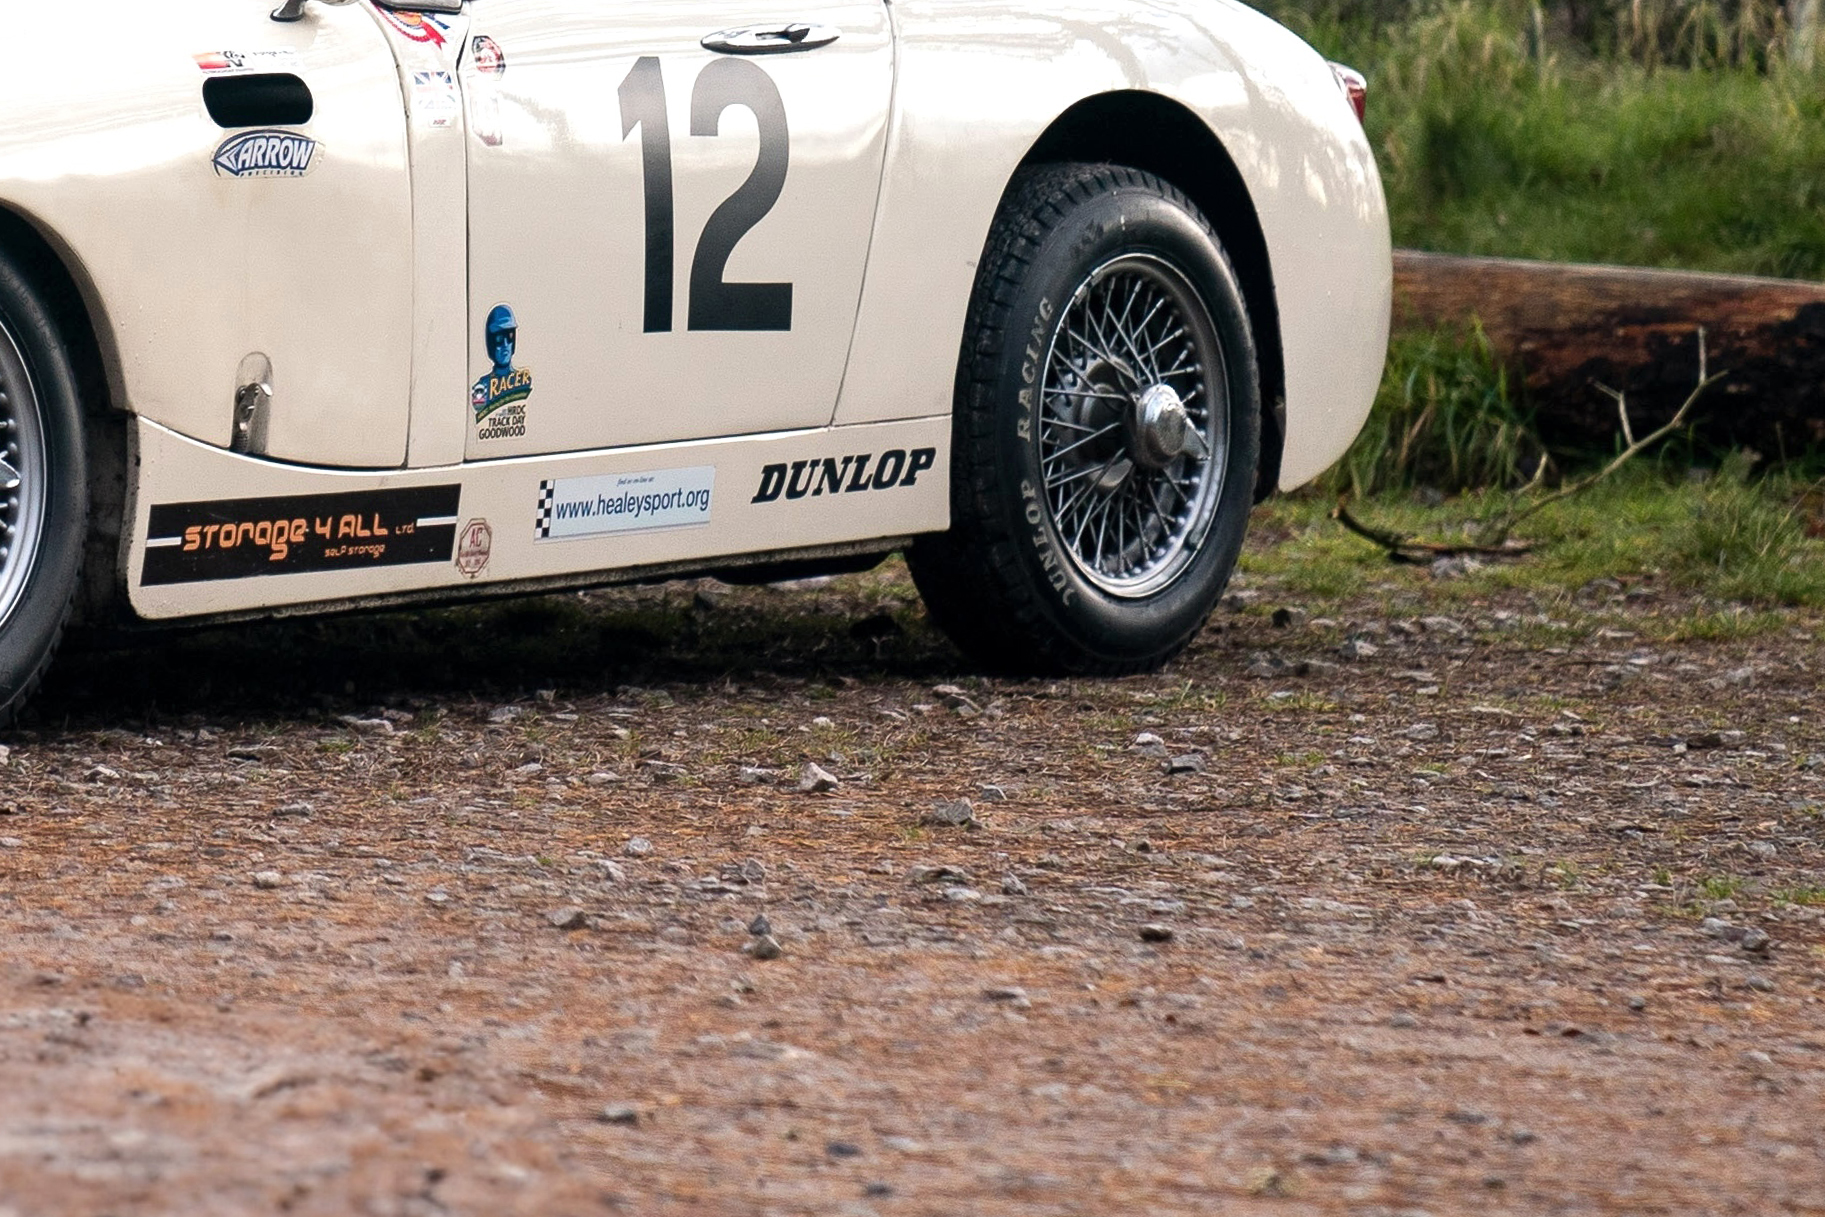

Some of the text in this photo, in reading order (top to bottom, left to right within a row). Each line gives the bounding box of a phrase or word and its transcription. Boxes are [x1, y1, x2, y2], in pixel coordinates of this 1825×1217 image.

[237, 136, 316, 170] ARROW
[617, 56, 793, 333] 12
[489, 368, 531, 400] RACER
[1018, 296, 1053, 442] RACING
[479, 425, 526, 440] GOODWOOD
[488, 417, 511, 427] TRACK
[750, 447, 936, 504] DUNLOP
[556, 488, 710, 519] www.healeysport.org
[315, 515, 333, 539] 4
[338, 513, 389, 538] ALL
